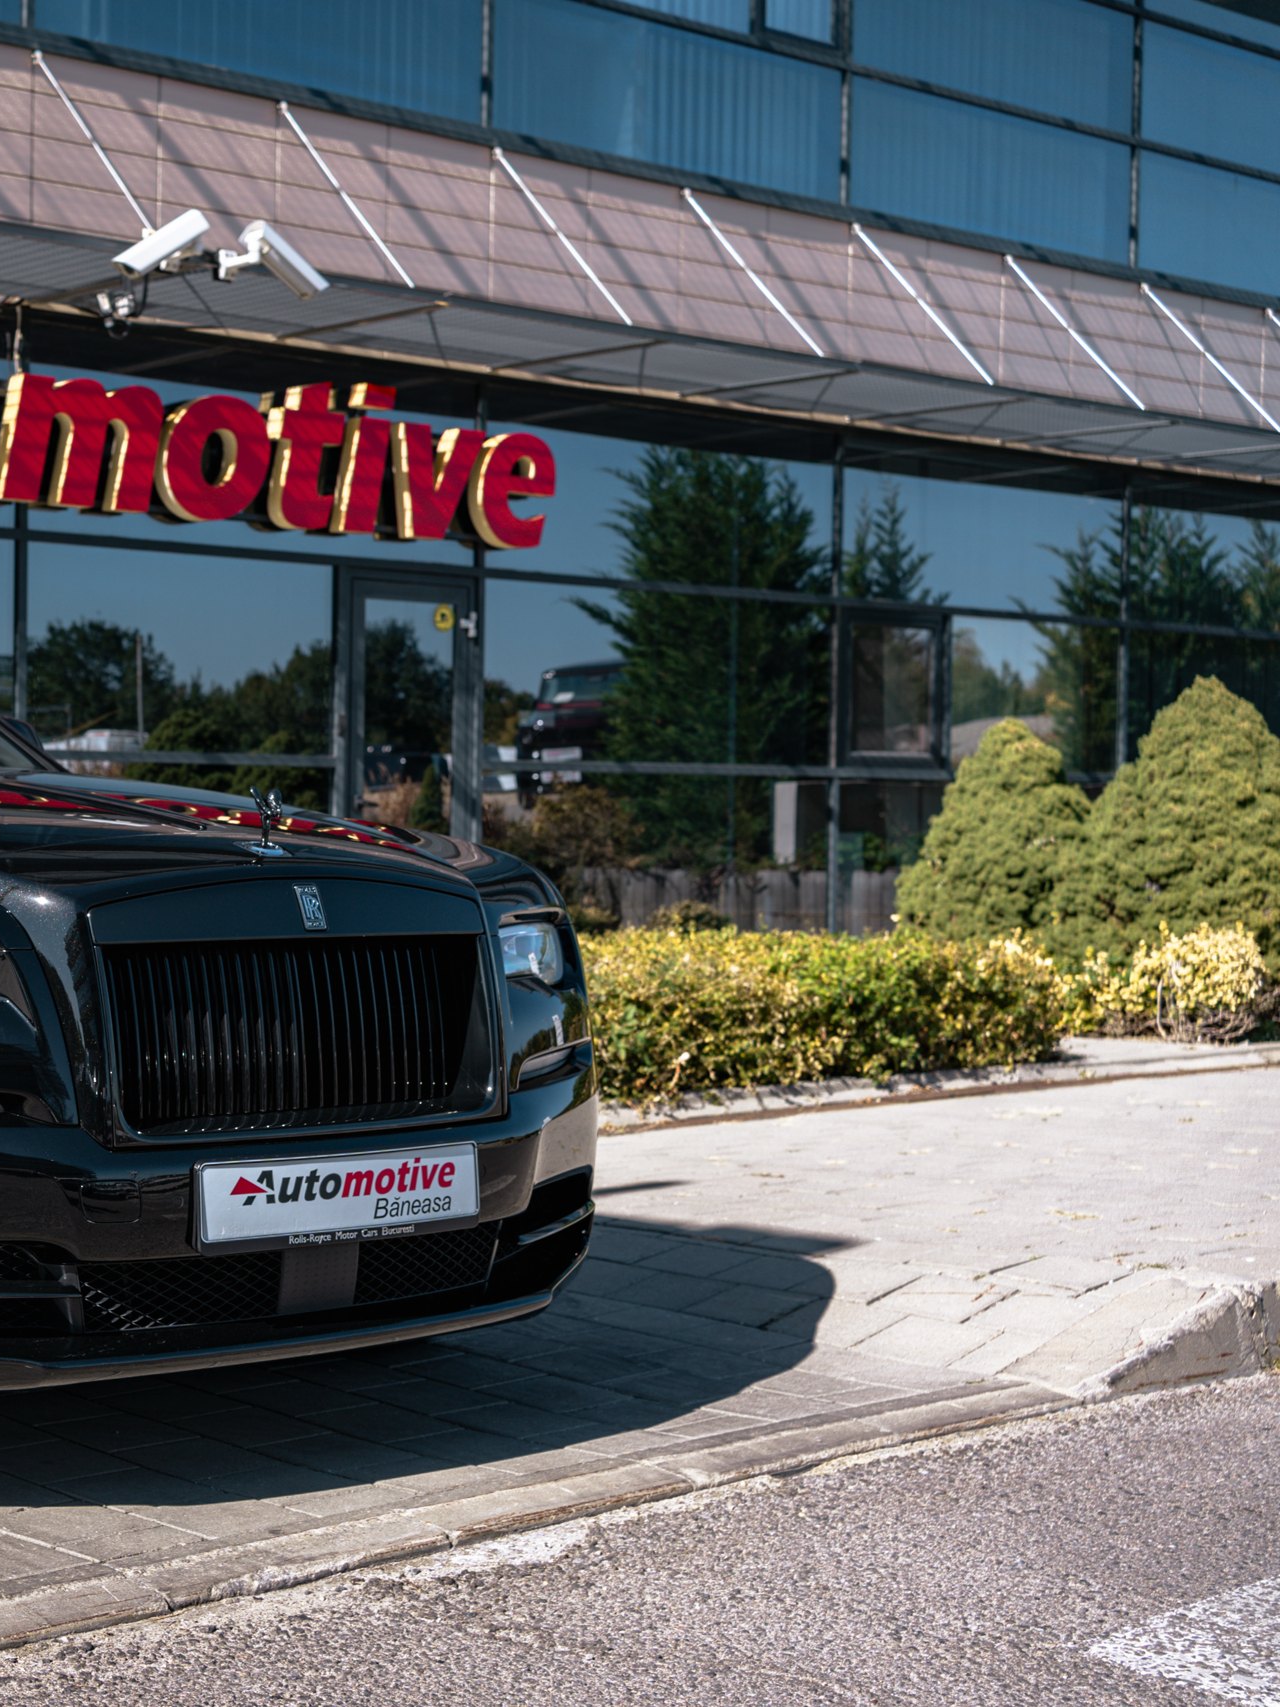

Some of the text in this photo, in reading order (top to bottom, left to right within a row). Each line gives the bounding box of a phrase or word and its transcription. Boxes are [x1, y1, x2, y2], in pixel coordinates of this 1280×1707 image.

[229, 1156, 456, 1206] Automotive
[373, 1195, 452, 1219] Băneasa
[288, 1233, 332, 1245] Rolls-Royce
[335, 1230, 358, 1240] Motor
[361, 1228, 378, 1238] Cars
